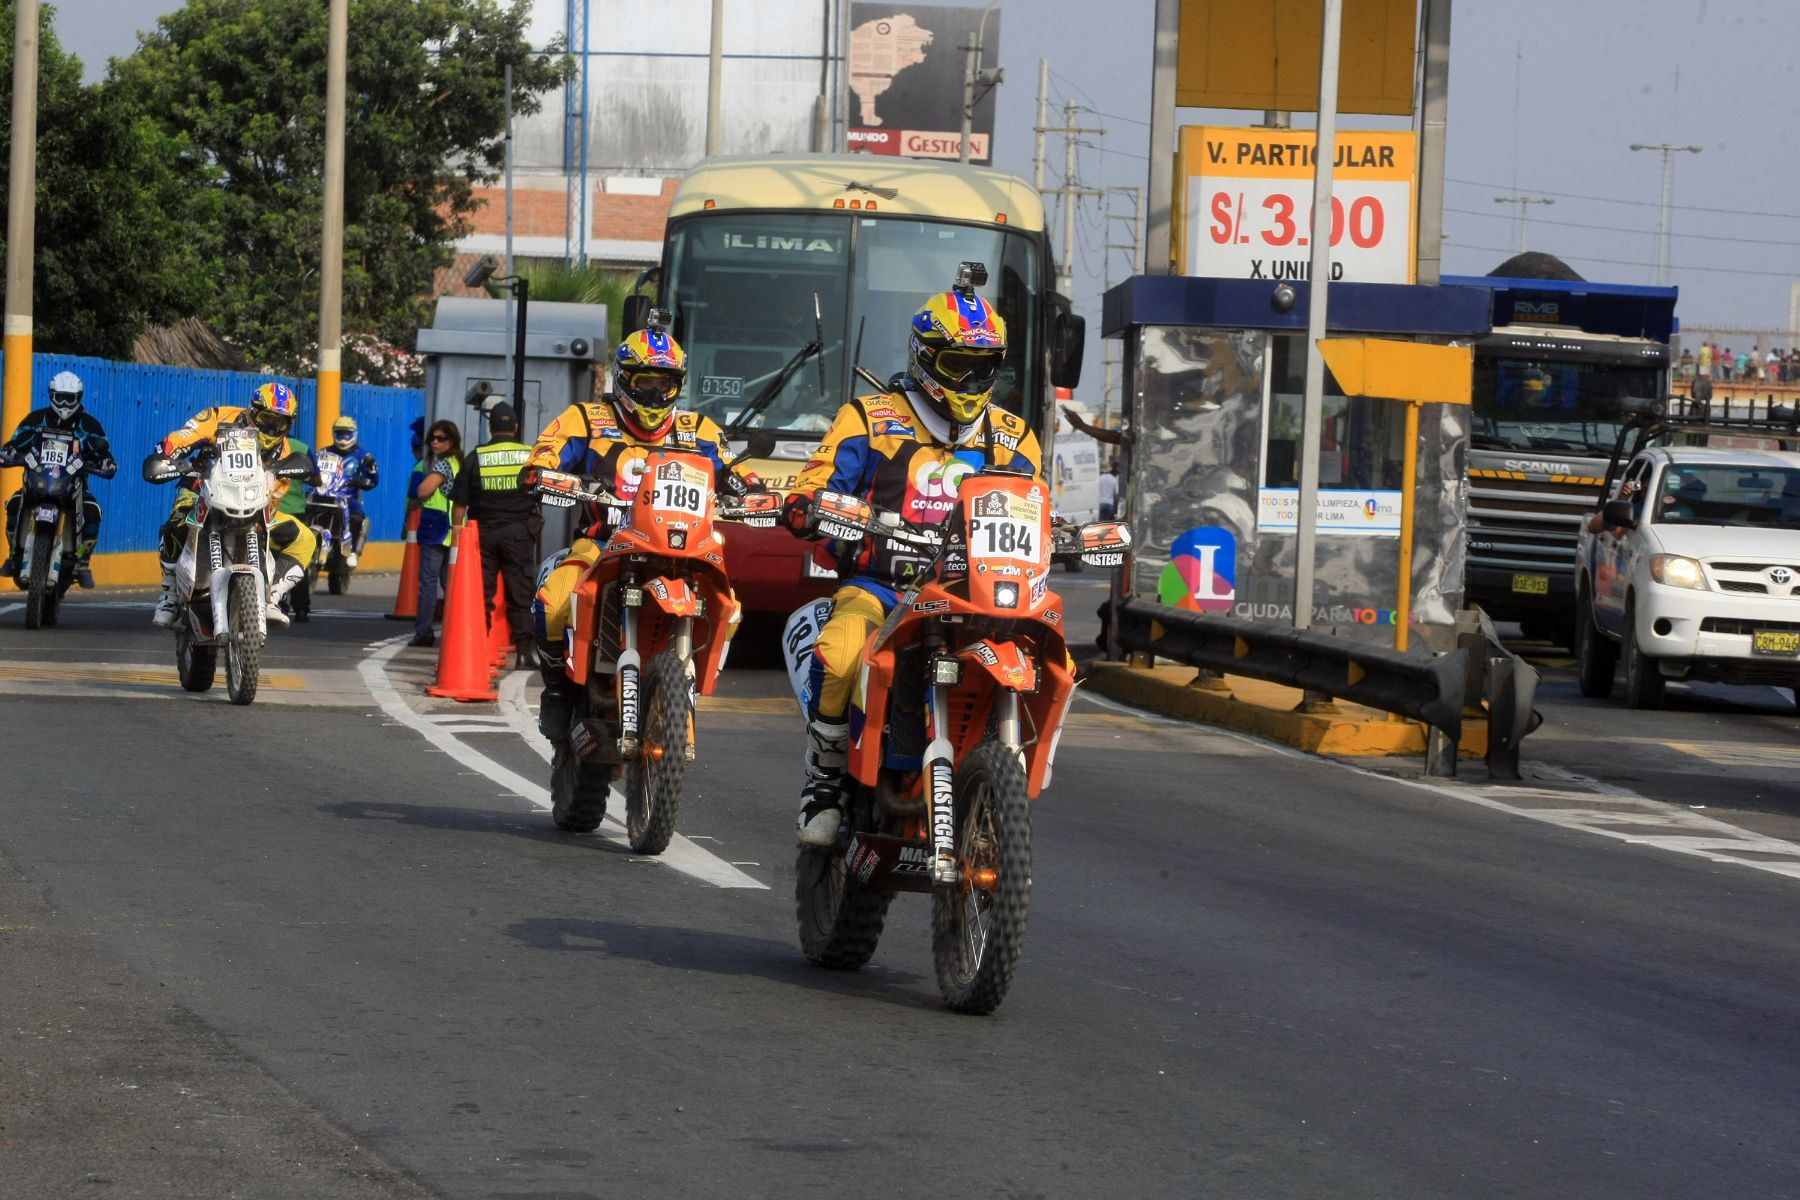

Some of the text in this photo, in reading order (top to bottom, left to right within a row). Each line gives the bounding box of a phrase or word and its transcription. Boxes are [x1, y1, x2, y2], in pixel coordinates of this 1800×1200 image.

[1207, 141, 1395, 168] V. PARTIULAR
[1210, 191, 1249, 245] S/.
[731, 234, 834, 252] LIMA
[1250, 259, 1267, 280] X.
[1514, 301, 1559, 314] RMB
[702, 379, 740, 395] 07:50
[45, 450, 64, 464] 185
[227, 453, 253, 469] 190
[1504, 459, 1572, 475] SCANIA
[484, 476, 518, 491] NACION
[541, 494, 577, 507] MASTECH
[663, 484, 700, 511] 189
[743, 517, 776, 527] MASTECH
[1325, 512, 1345, 521] LIMA
[818, 520, 864, 541] MASTECH
[984, 521, 1032, 557] 184
[1082, 552, 1124, 566] MASTECH
[1235, 603, 1292, 622] CIUDA
[787, 615, 813, 673] 184
[623, 669, 638, 733] MASTECH
[933, 765, 954, 850] MASTECH
